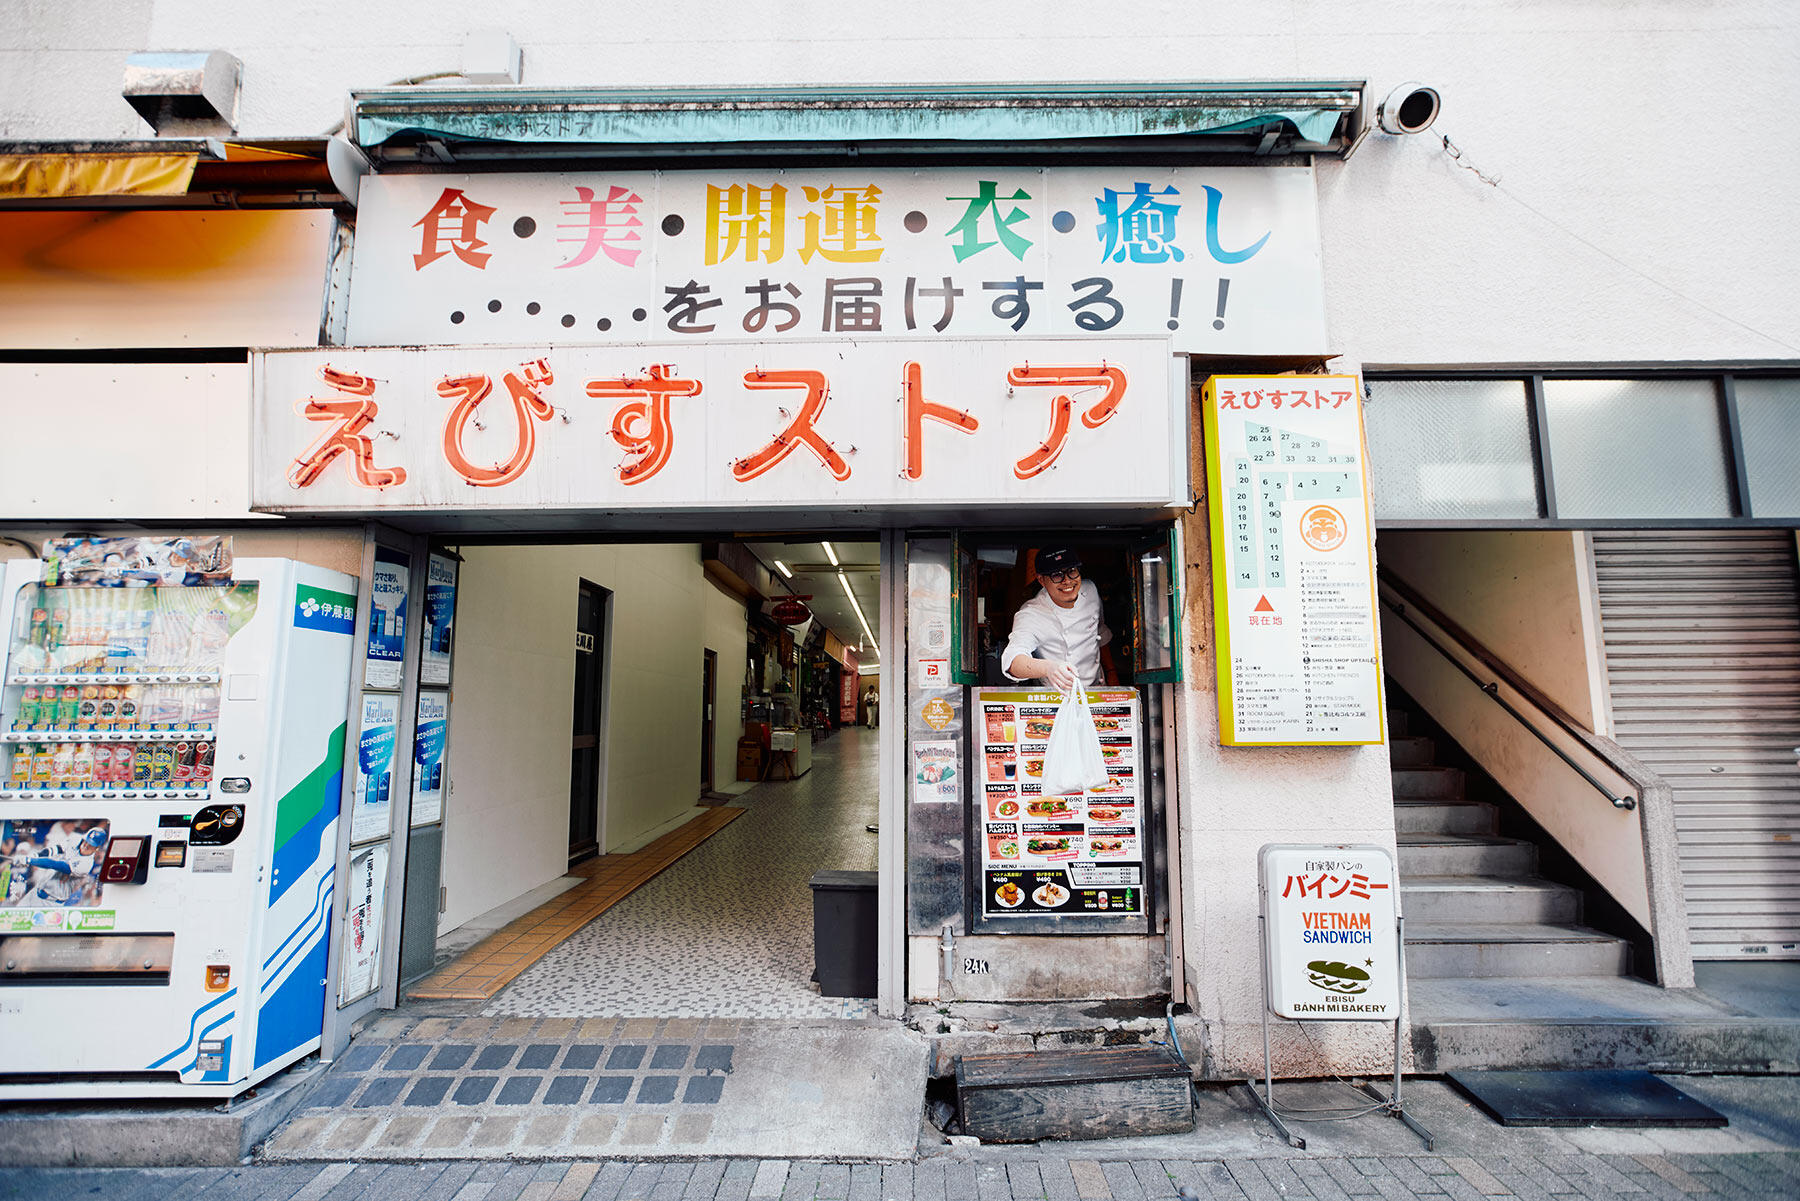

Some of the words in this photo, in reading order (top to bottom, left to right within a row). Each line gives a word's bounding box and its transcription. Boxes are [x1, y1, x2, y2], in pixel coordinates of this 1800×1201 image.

[1221, 389, 1352, 409] えびすストア
[285, 357, 1130, 490] えびすストア
[430, 575, 453, 584] CLEAR
[321, 602, 354, 621] 伊藤園
[1249, 616, 1282, 625] 現在地
[368, 649, 401, 658] CLEAR
[366, 701, 393, 718] Marlboro
[420, 697, 444, 714] Marlboro
[1305, 861, 1363, 871] 自家製パンの
[1282, 873, 1389, 900] バインミー
[1302, 912, 1371, 930] VIETNAM
[1303, 931, 1372, 944] SANDWICH
[964, 958, 990, 974] 24K
[1341, 1004, 1387, 1012] BAKERY
